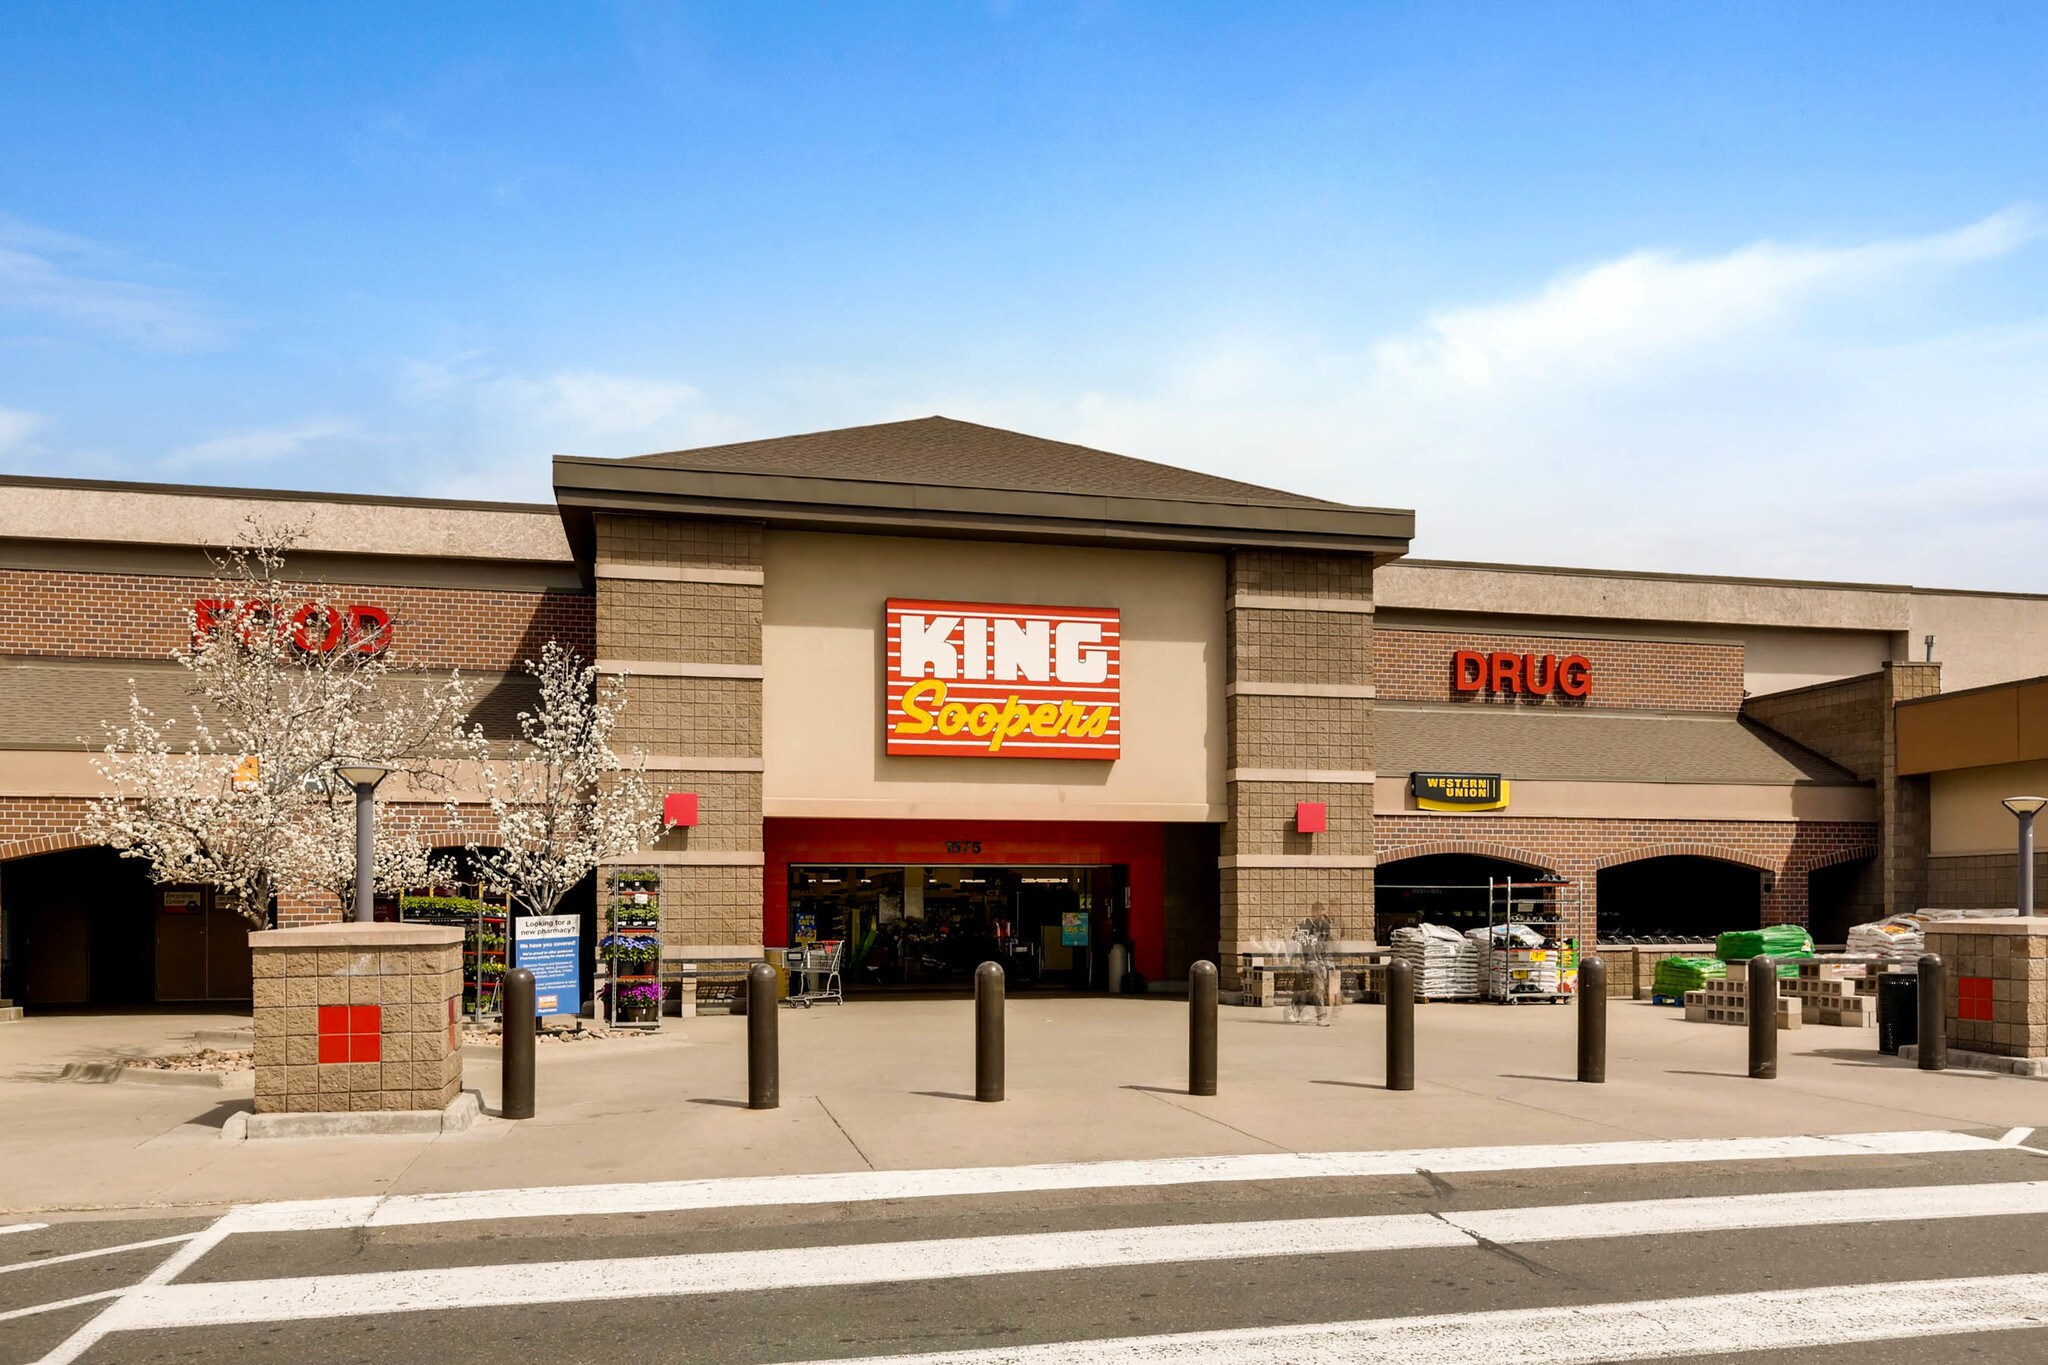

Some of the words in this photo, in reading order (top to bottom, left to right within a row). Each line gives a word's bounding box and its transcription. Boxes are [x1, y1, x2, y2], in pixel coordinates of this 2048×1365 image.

[900, 615, 1108, 683] KING
[1454, 650, 1592, 696] DRUG
[894, 678, 1112, 752] Soopers
[1427, 778, 1487, 788] WESTERN
[1446, 788, 1487, 797] UNION
[537, 927, 576, 935] pharmacy?
